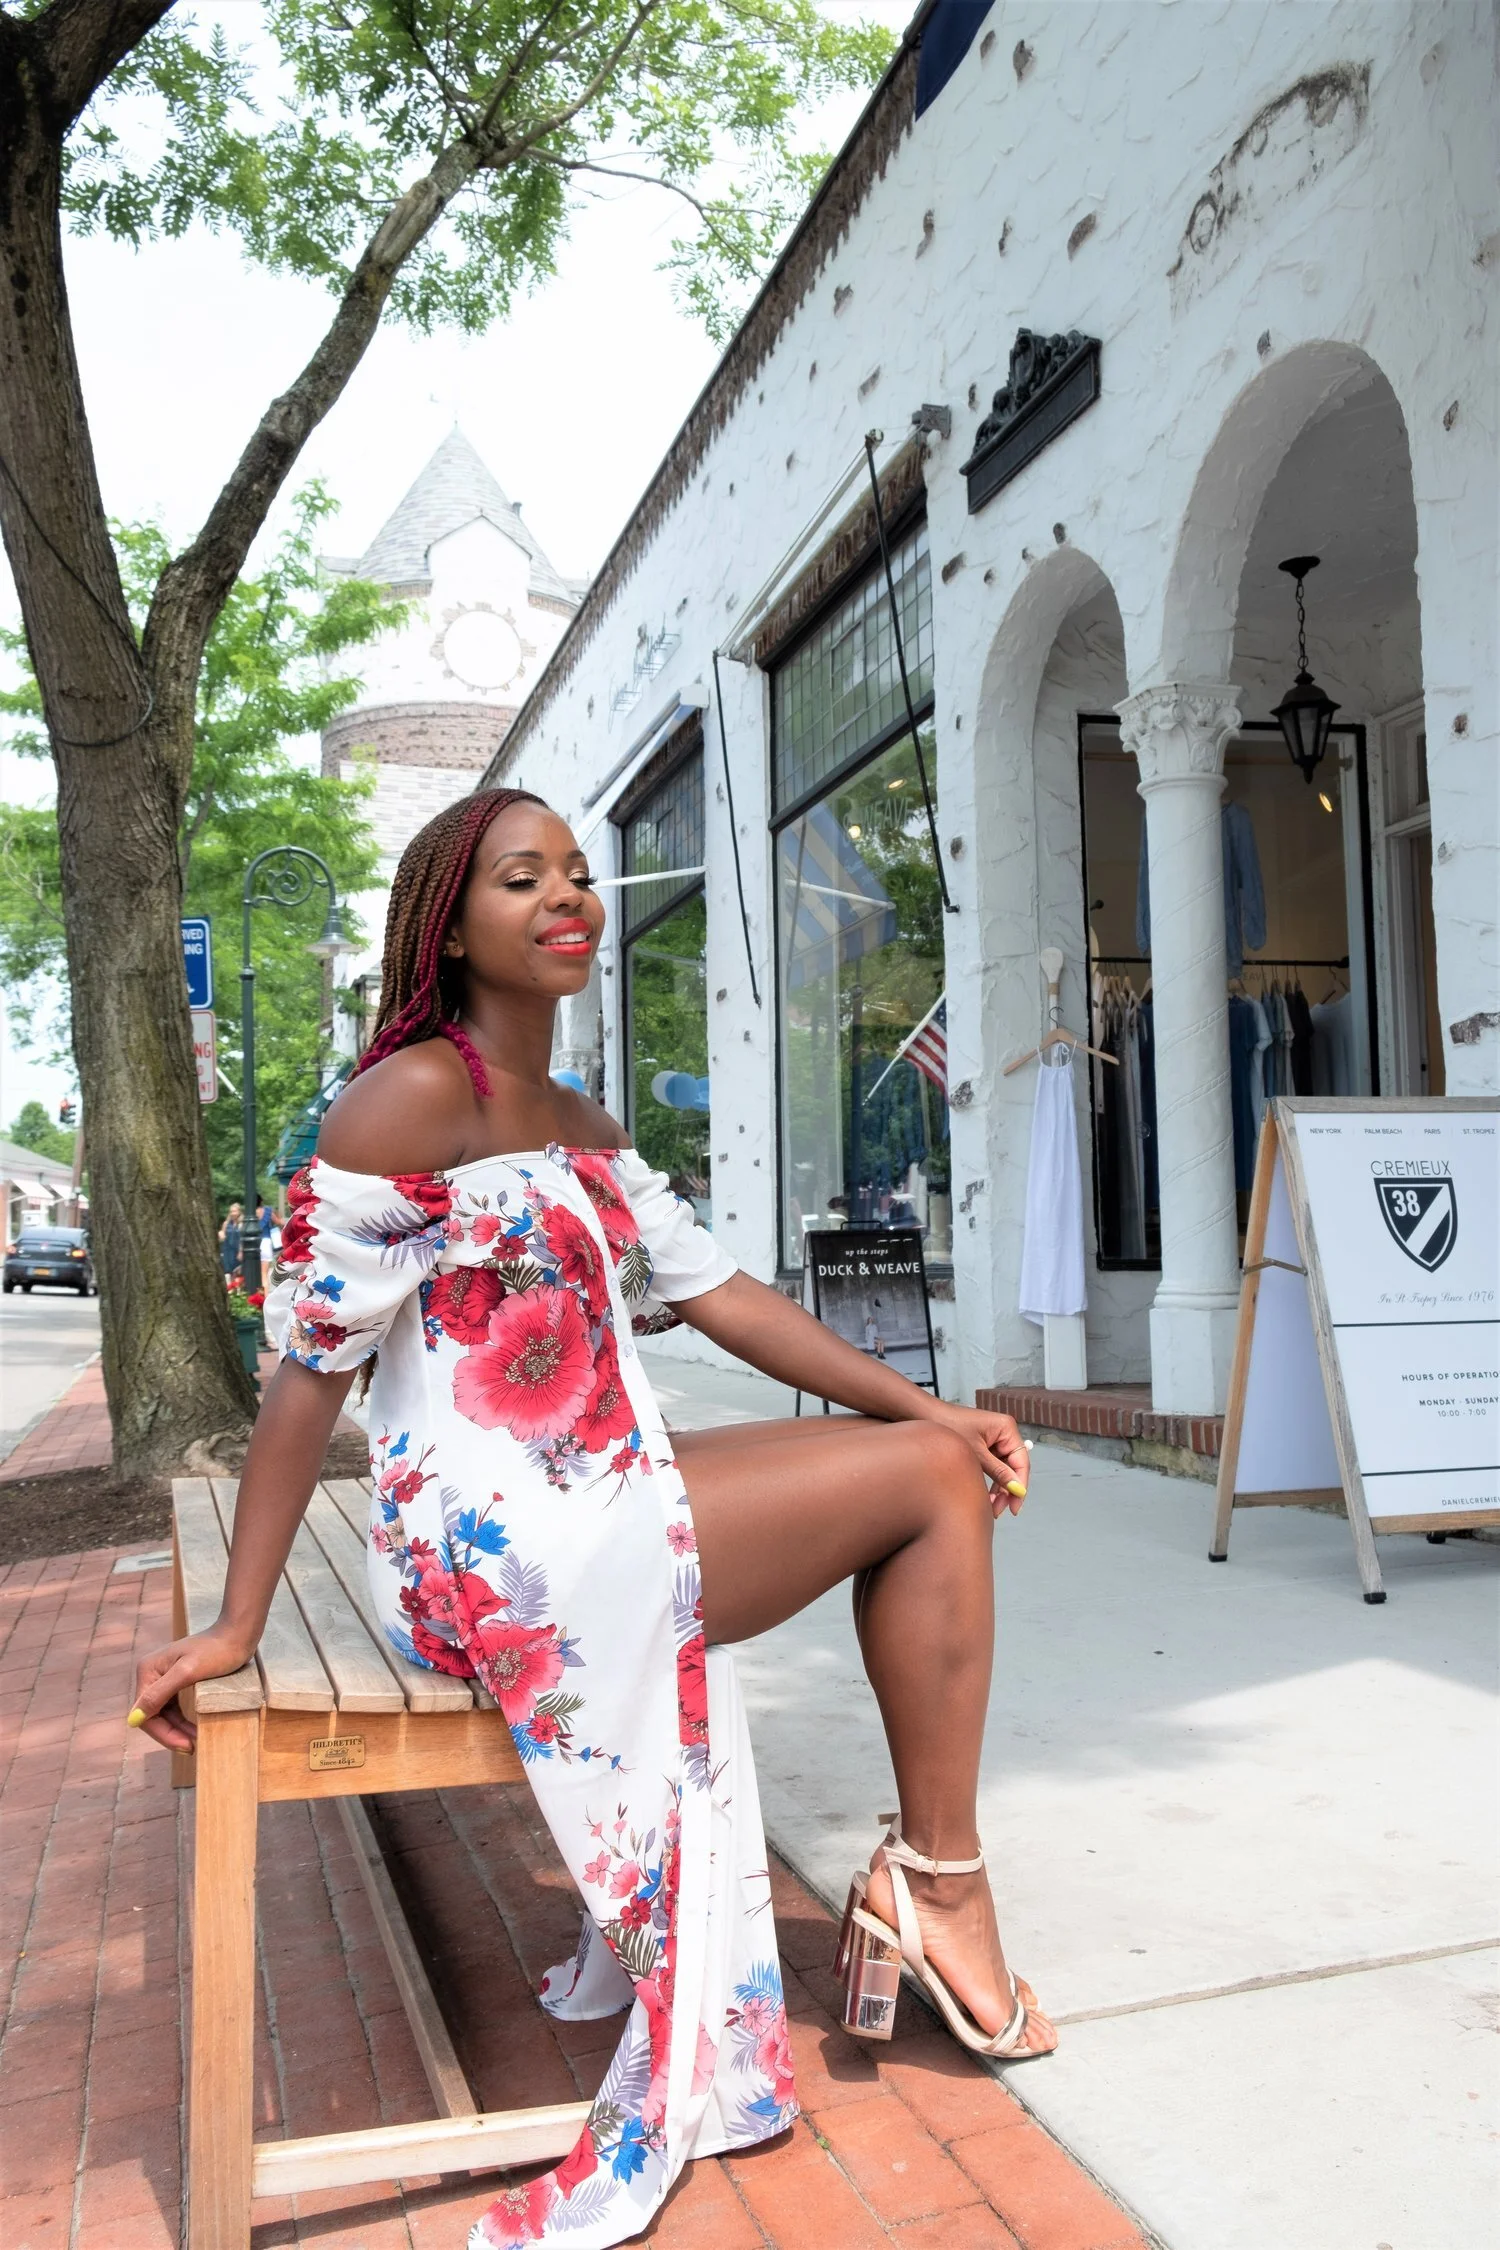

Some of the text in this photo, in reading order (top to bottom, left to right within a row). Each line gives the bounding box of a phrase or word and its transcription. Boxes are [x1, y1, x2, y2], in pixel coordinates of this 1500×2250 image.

[1370, 1160, 1451, 1176] CREMIEUX
[1391, 1189, 1421, 1217] 38
[845, 1249, 854, 1257] up
[870, 1248, 888, 1256] steps
[818, 1262, 920, 1276] DUCK & WEAVE
[1440, 1292, 1463, 1302] Since
[1468, 1290, 1495, 1304] 1976
[1401, 1371, 1499, 1381] HOURS OF OPERATIO
[1465, 1396, 1499, 1405] SUNDAY
[1468, 1408, 1487, 1416] 7:00
[319, 1757, 355, 1767] Since 1842
